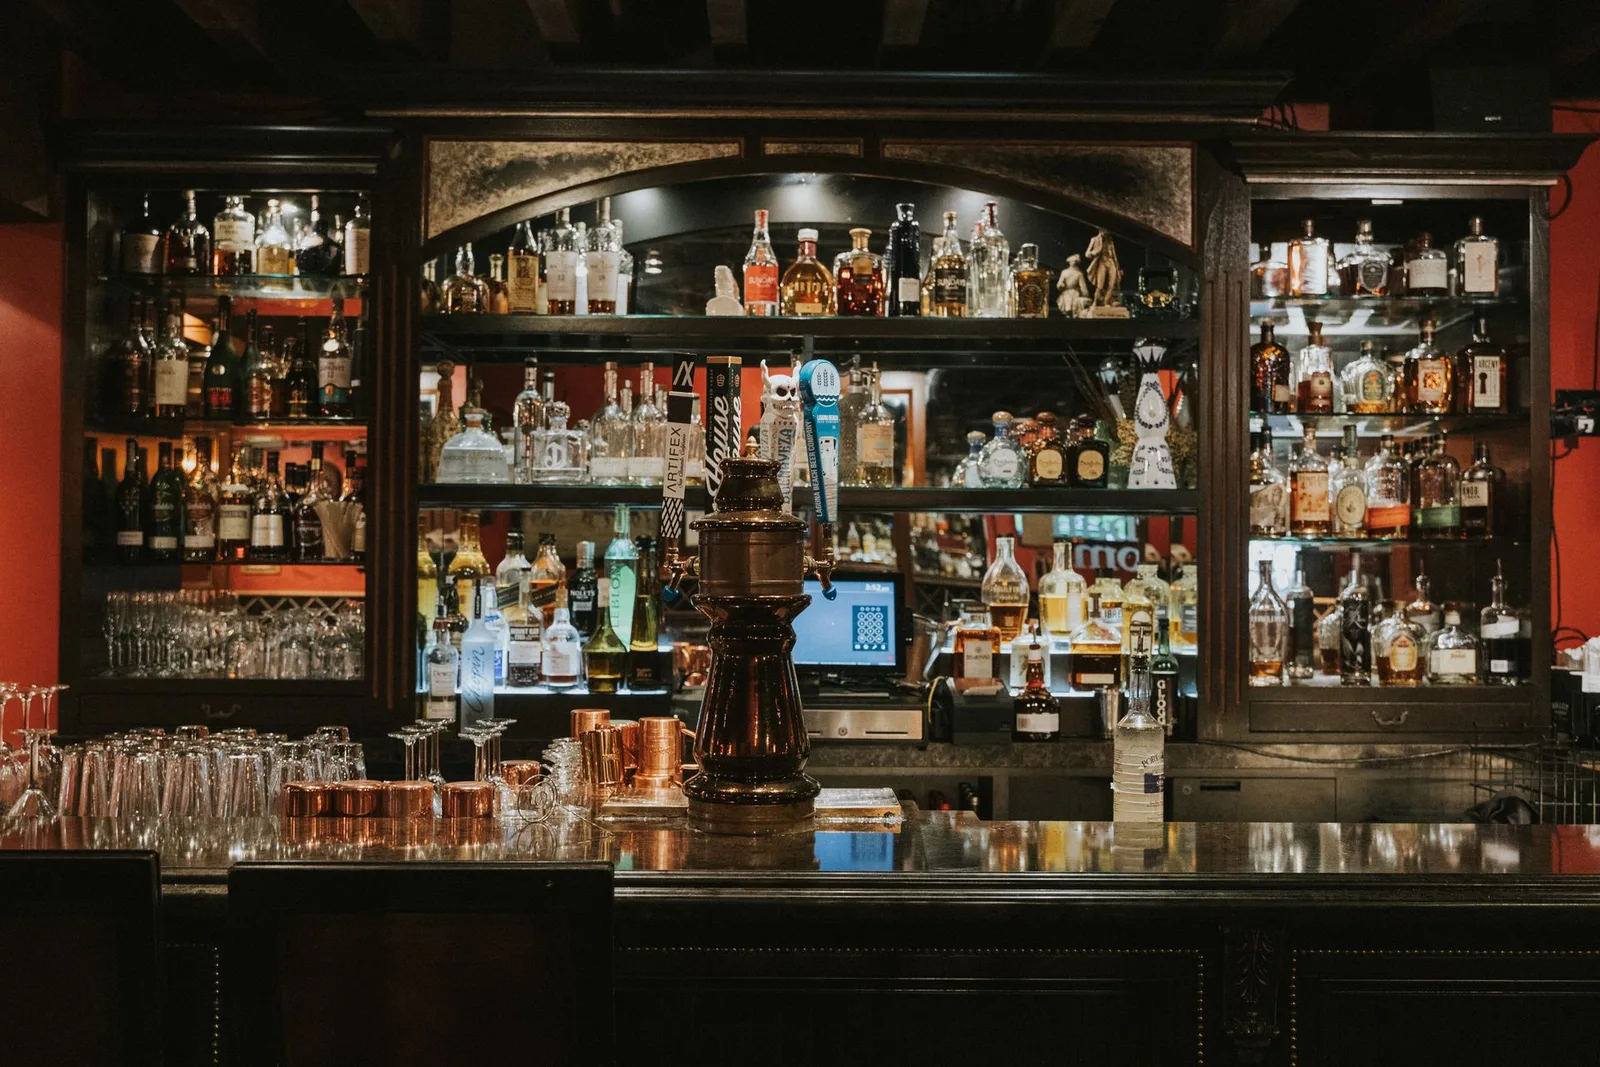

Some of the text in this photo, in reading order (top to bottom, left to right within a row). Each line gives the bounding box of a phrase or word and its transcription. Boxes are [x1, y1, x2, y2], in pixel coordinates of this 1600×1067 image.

[667, 426, 681, 493] ARTIFEX
[732, 395, 741, 458] ouse
[805, 421, 823, 517] LAGUNA BEACH BEER COMPANY
